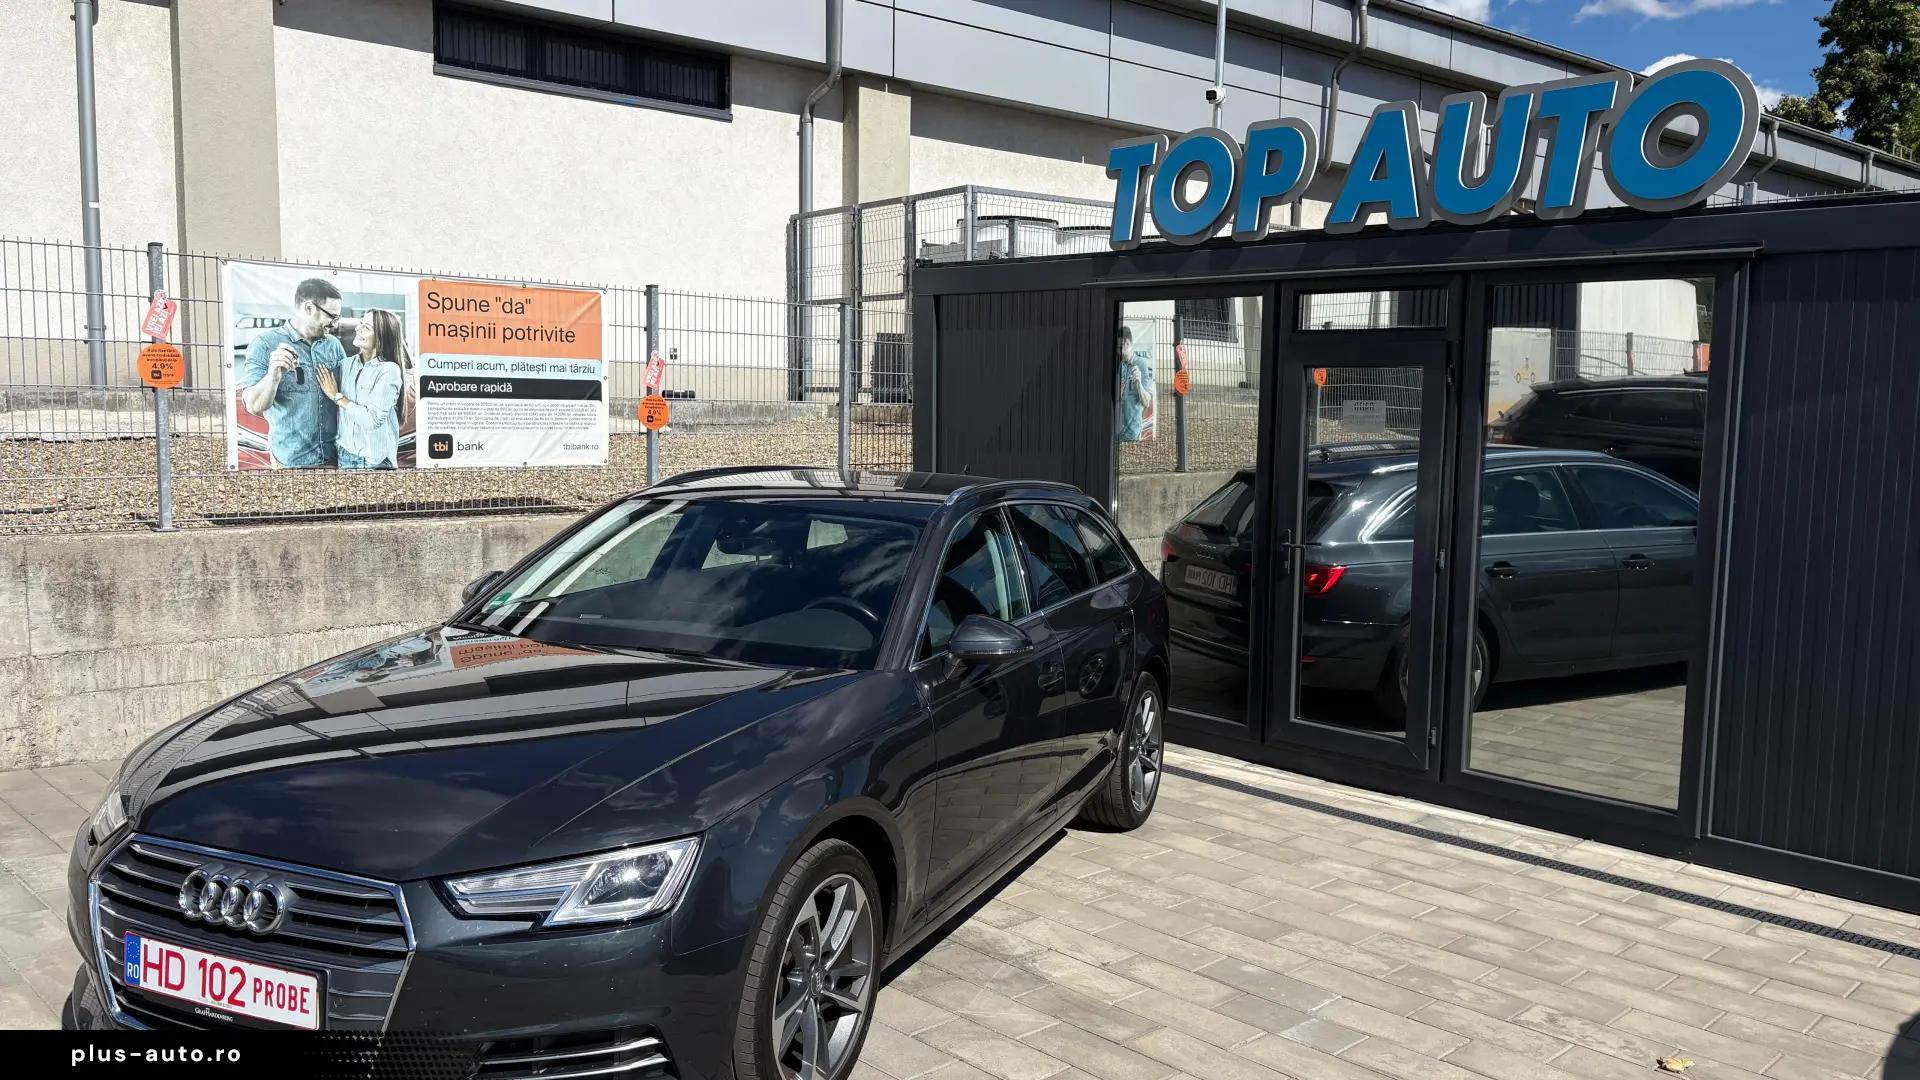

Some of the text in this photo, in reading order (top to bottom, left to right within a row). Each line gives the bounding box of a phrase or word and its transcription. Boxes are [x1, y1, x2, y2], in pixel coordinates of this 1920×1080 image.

[1106, 62, 1752, 248] TOP AUTO
[427, 291, 532, 314] Spune "da"
[428, 321, 576, 344] mașinii potrivite
[427, 358, 596, 374] Cumperi acum, plătești mai târziu
[427, 381, 513, 394] Aprobare rapidă
[433, 441, 448, 452] tbi
[457, 441, 484, 451] bank
[127, 962, 140, 979] RO
[142, 944, 310, 1014] HD 102 PROBE
